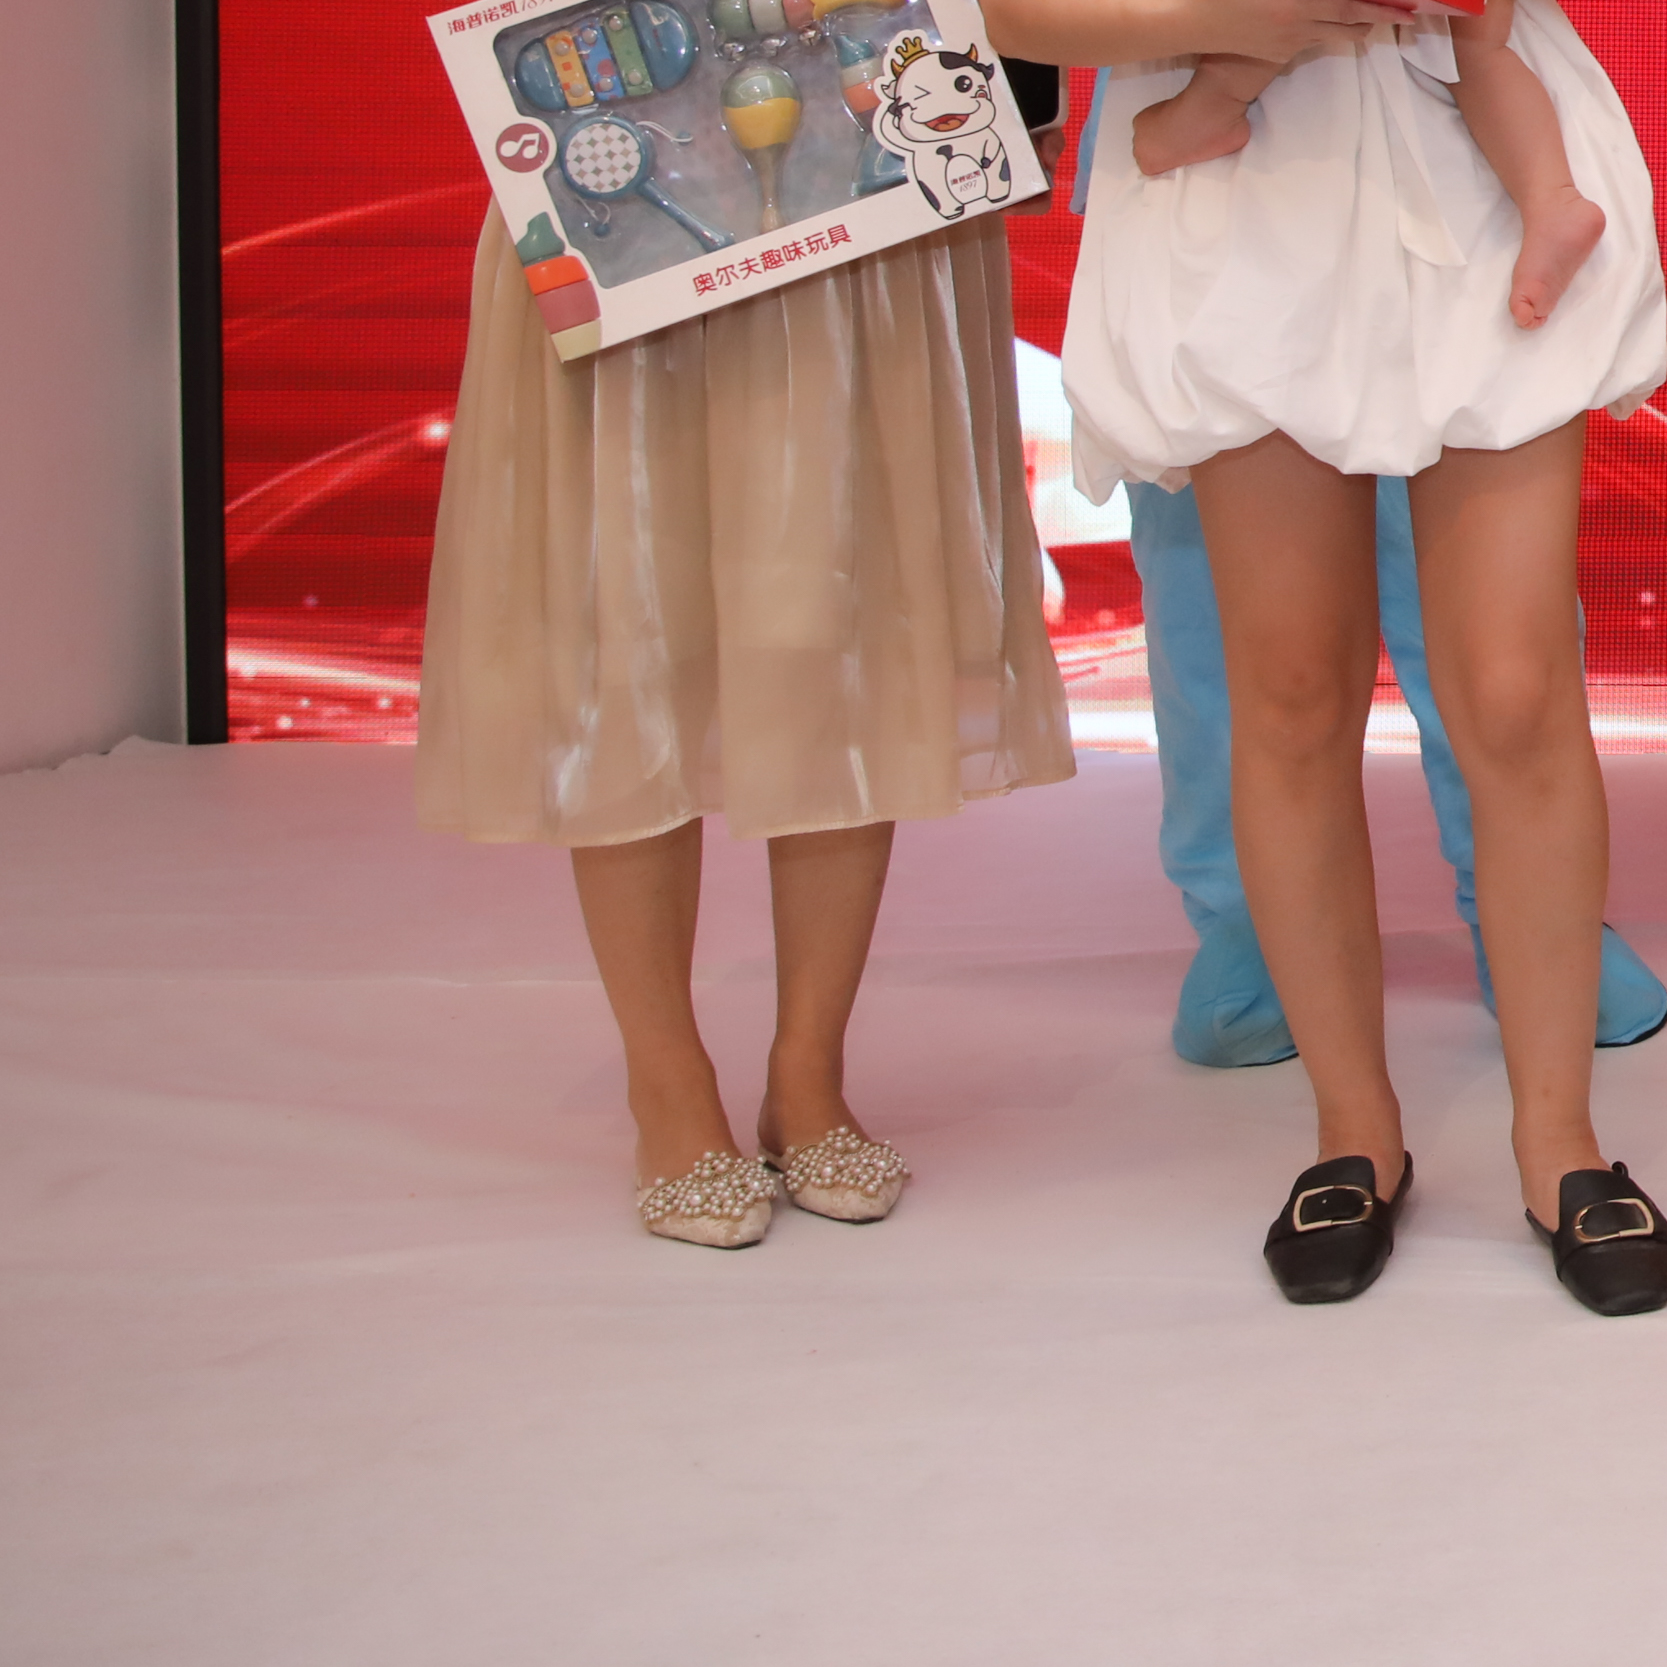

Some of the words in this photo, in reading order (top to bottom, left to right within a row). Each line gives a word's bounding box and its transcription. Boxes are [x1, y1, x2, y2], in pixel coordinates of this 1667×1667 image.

[692, 223, 852, 297] 奥尔夫趣味玩具
